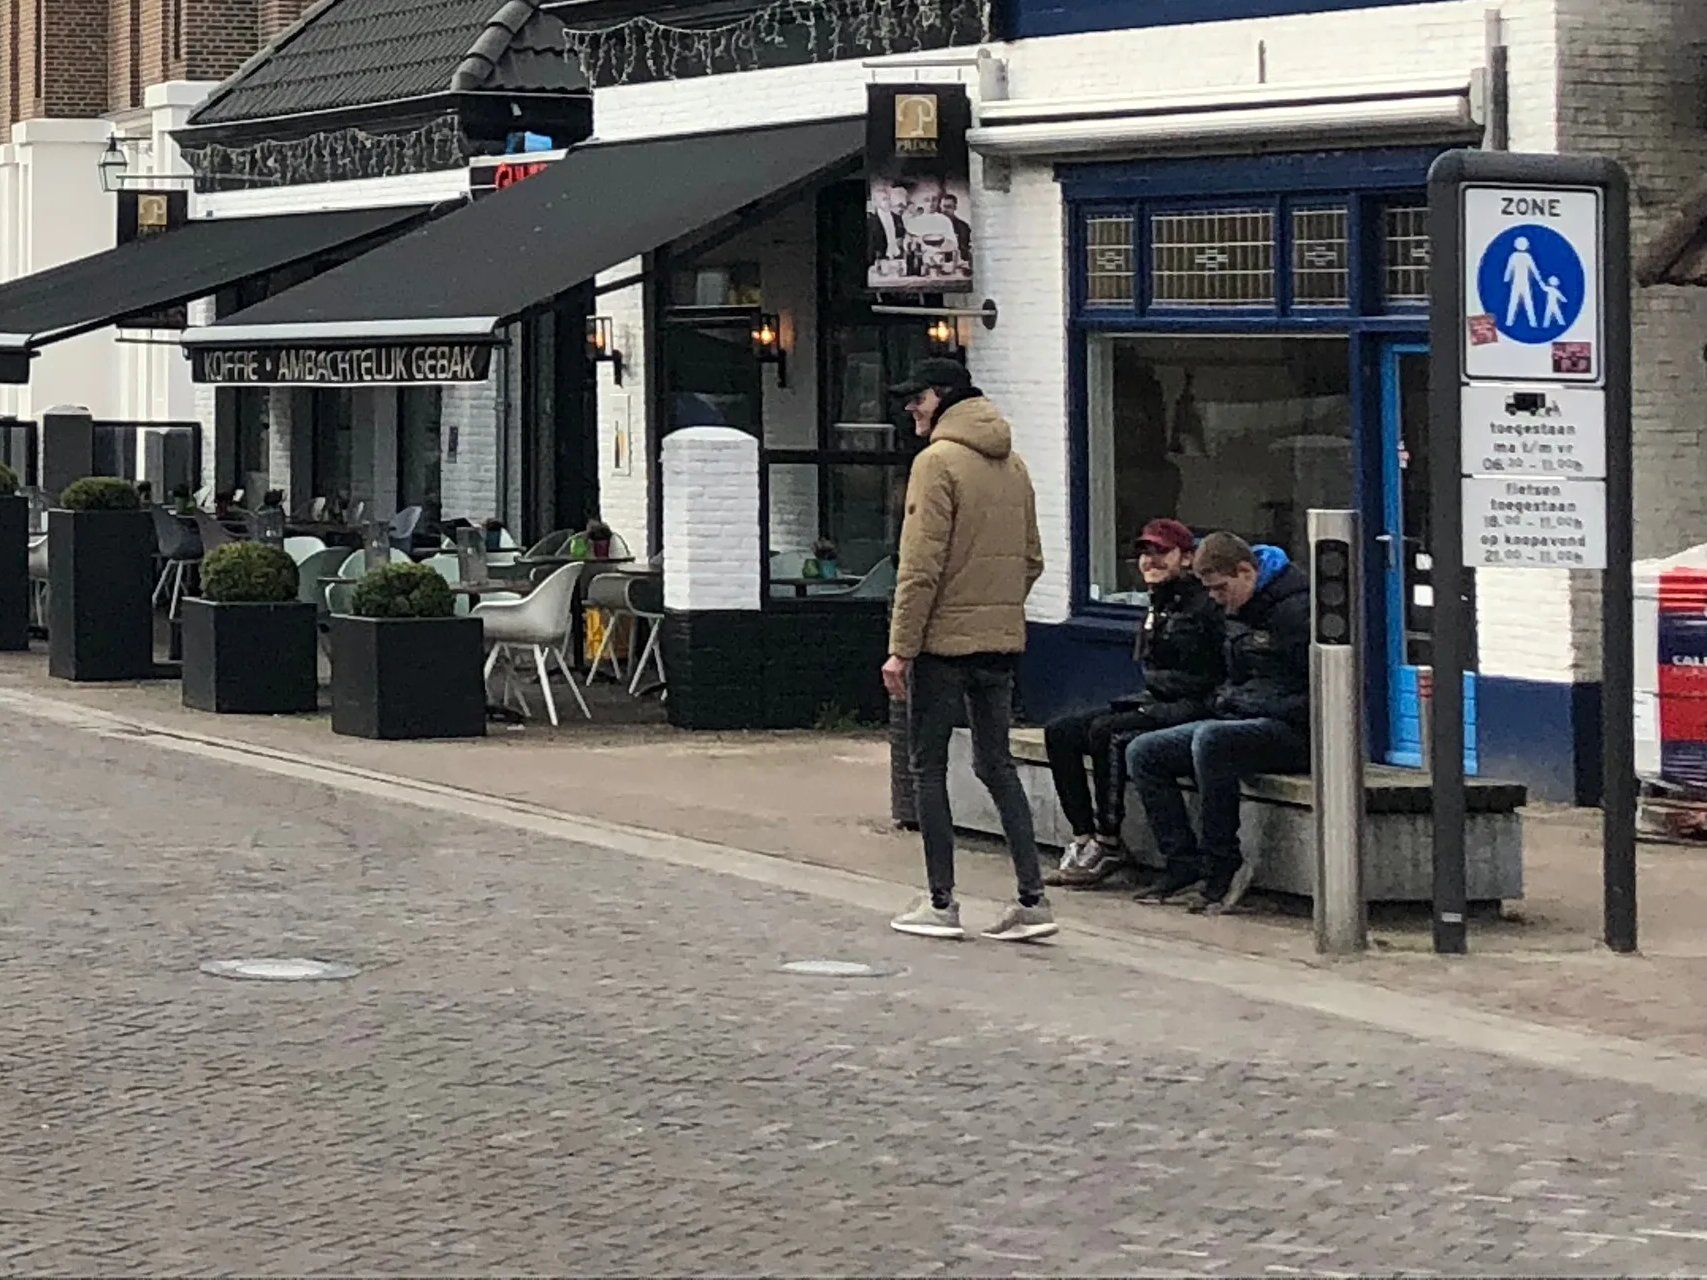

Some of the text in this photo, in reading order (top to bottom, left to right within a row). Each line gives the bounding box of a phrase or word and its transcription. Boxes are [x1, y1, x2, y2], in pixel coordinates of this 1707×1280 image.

[1501, 197, 1561, 217] ZONE
[203, 349, 259, 381] KOFFIE
[411, 345, 478, 380] GEBAK
[1490, 421, 1576, 437] toegestaan
[1490, 499, 1577, 514] toegestaan
